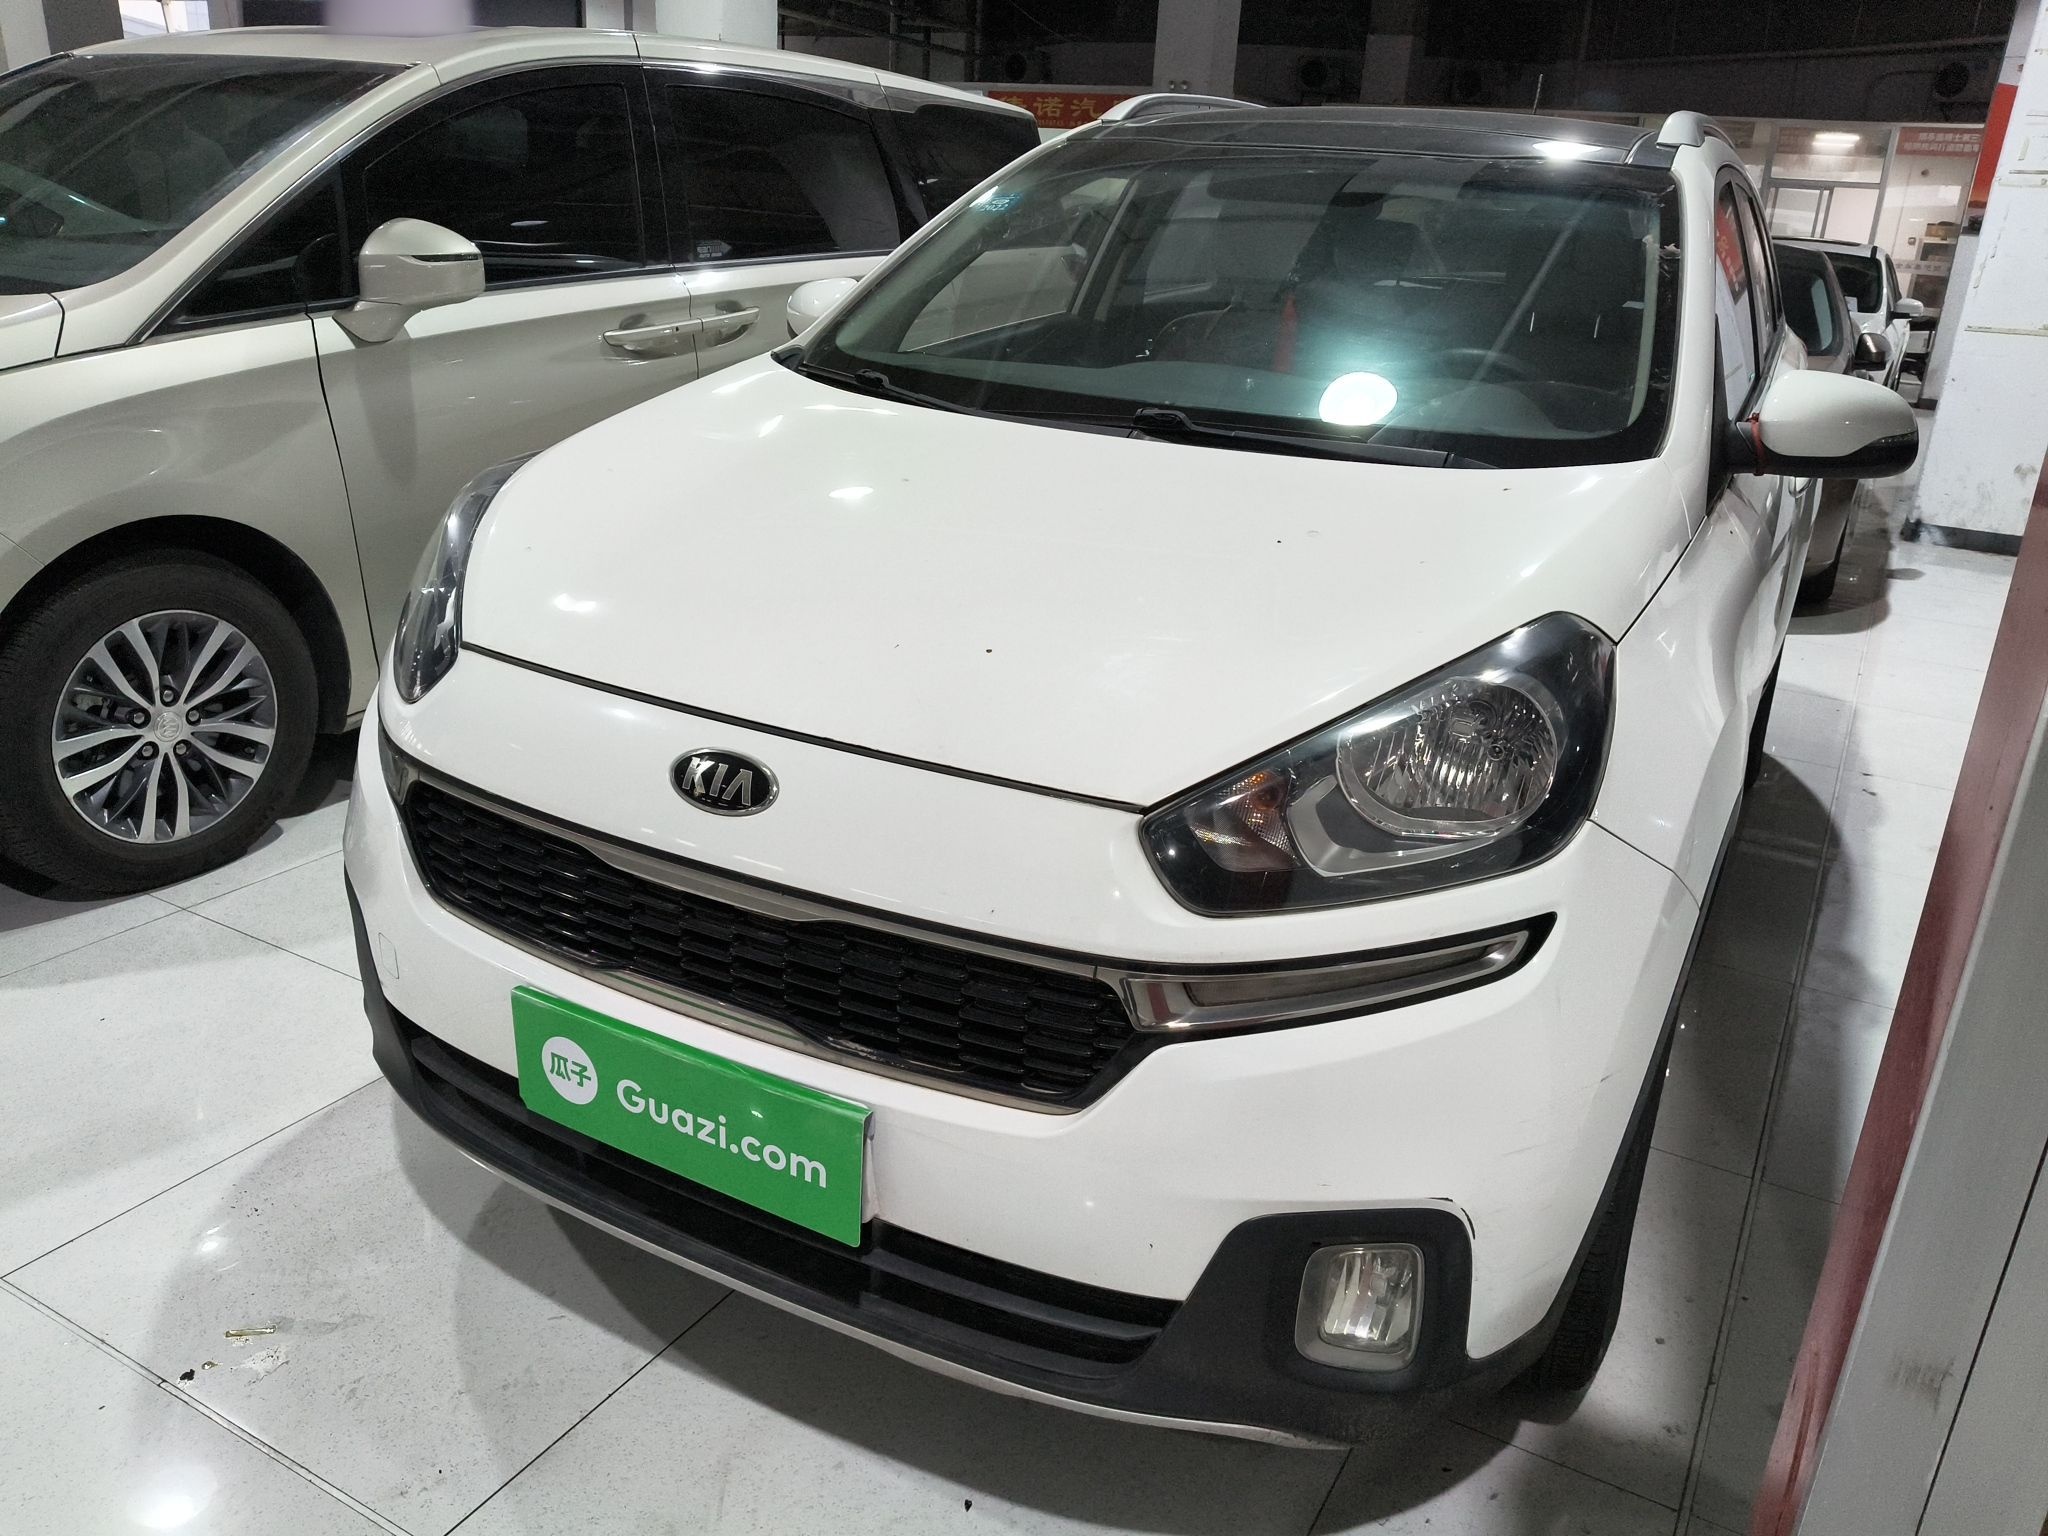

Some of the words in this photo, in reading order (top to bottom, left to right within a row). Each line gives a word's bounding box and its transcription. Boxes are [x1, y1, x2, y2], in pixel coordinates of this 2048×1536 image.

[1000, 95, 1120, 119] 诺汽
[682, 756, 752, 806] KIA
[549, 1052, 591, 1088] 瓜子
[616, 1078, 827, 1189] Guazi.com
